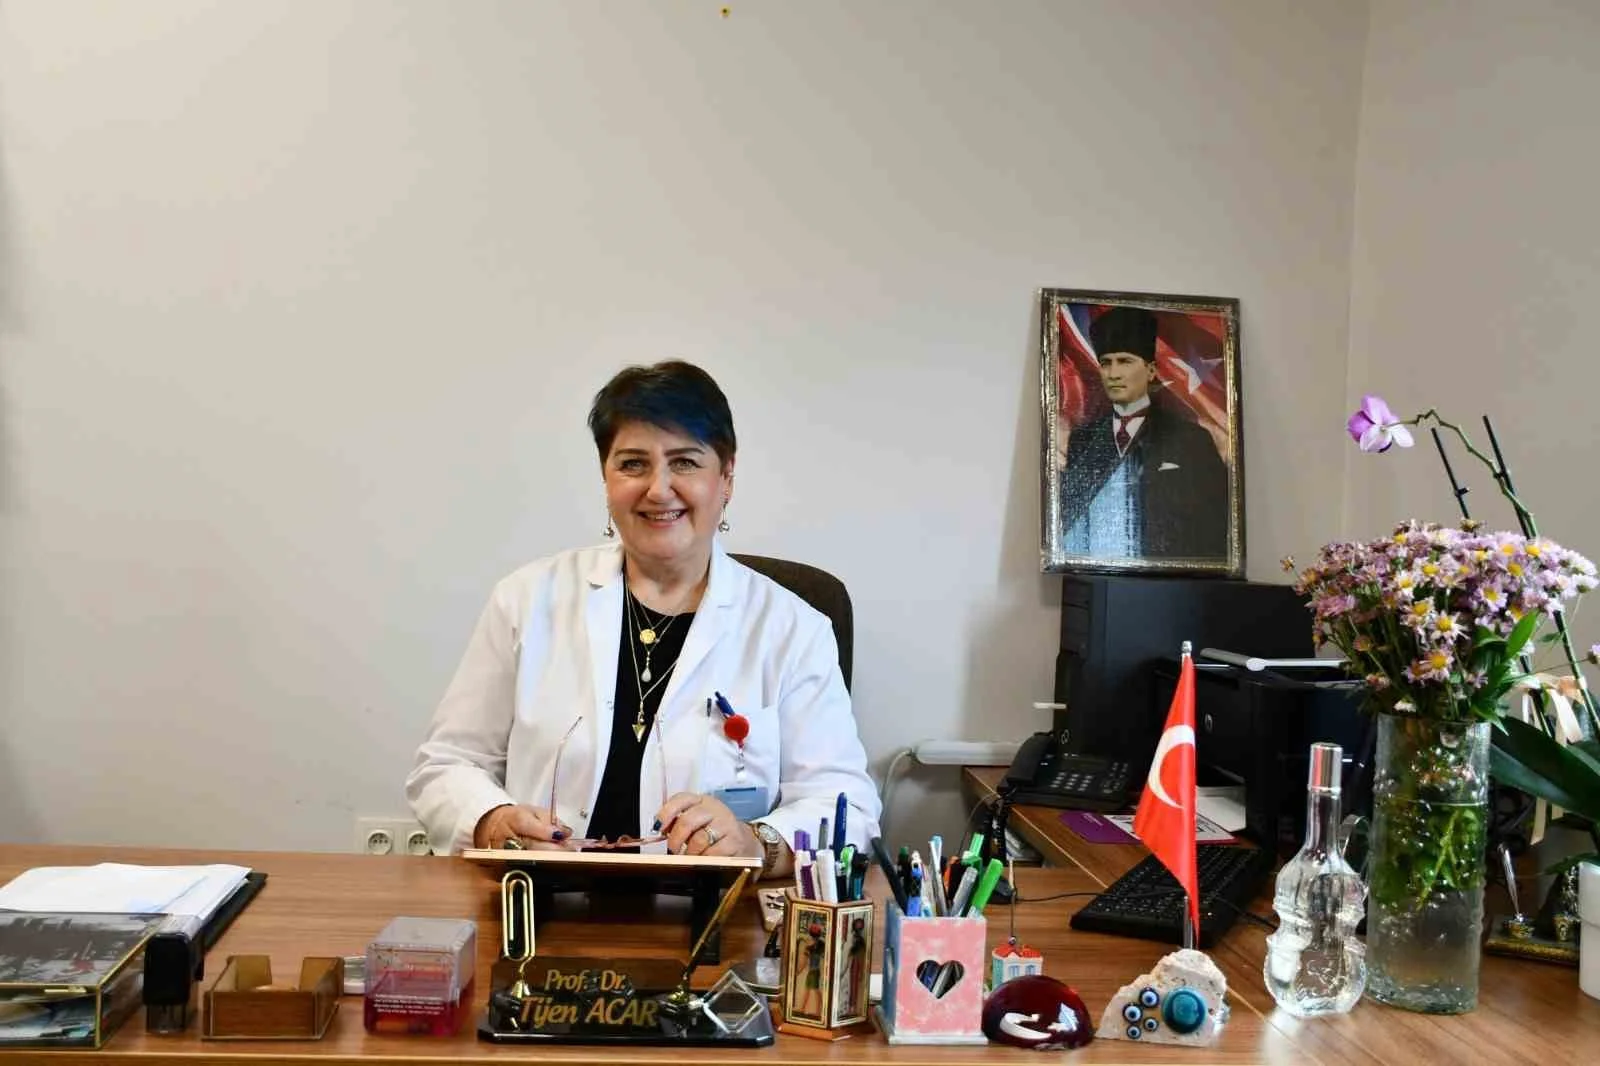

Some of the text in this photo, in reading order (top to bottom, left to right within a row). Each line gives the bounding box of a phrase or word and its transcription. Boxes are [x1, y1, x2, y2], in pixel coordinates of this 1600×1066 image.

[544, 968, 627, 992] Prof. Dr.
[519, 996, 659, 1029] Tijen ACAR
